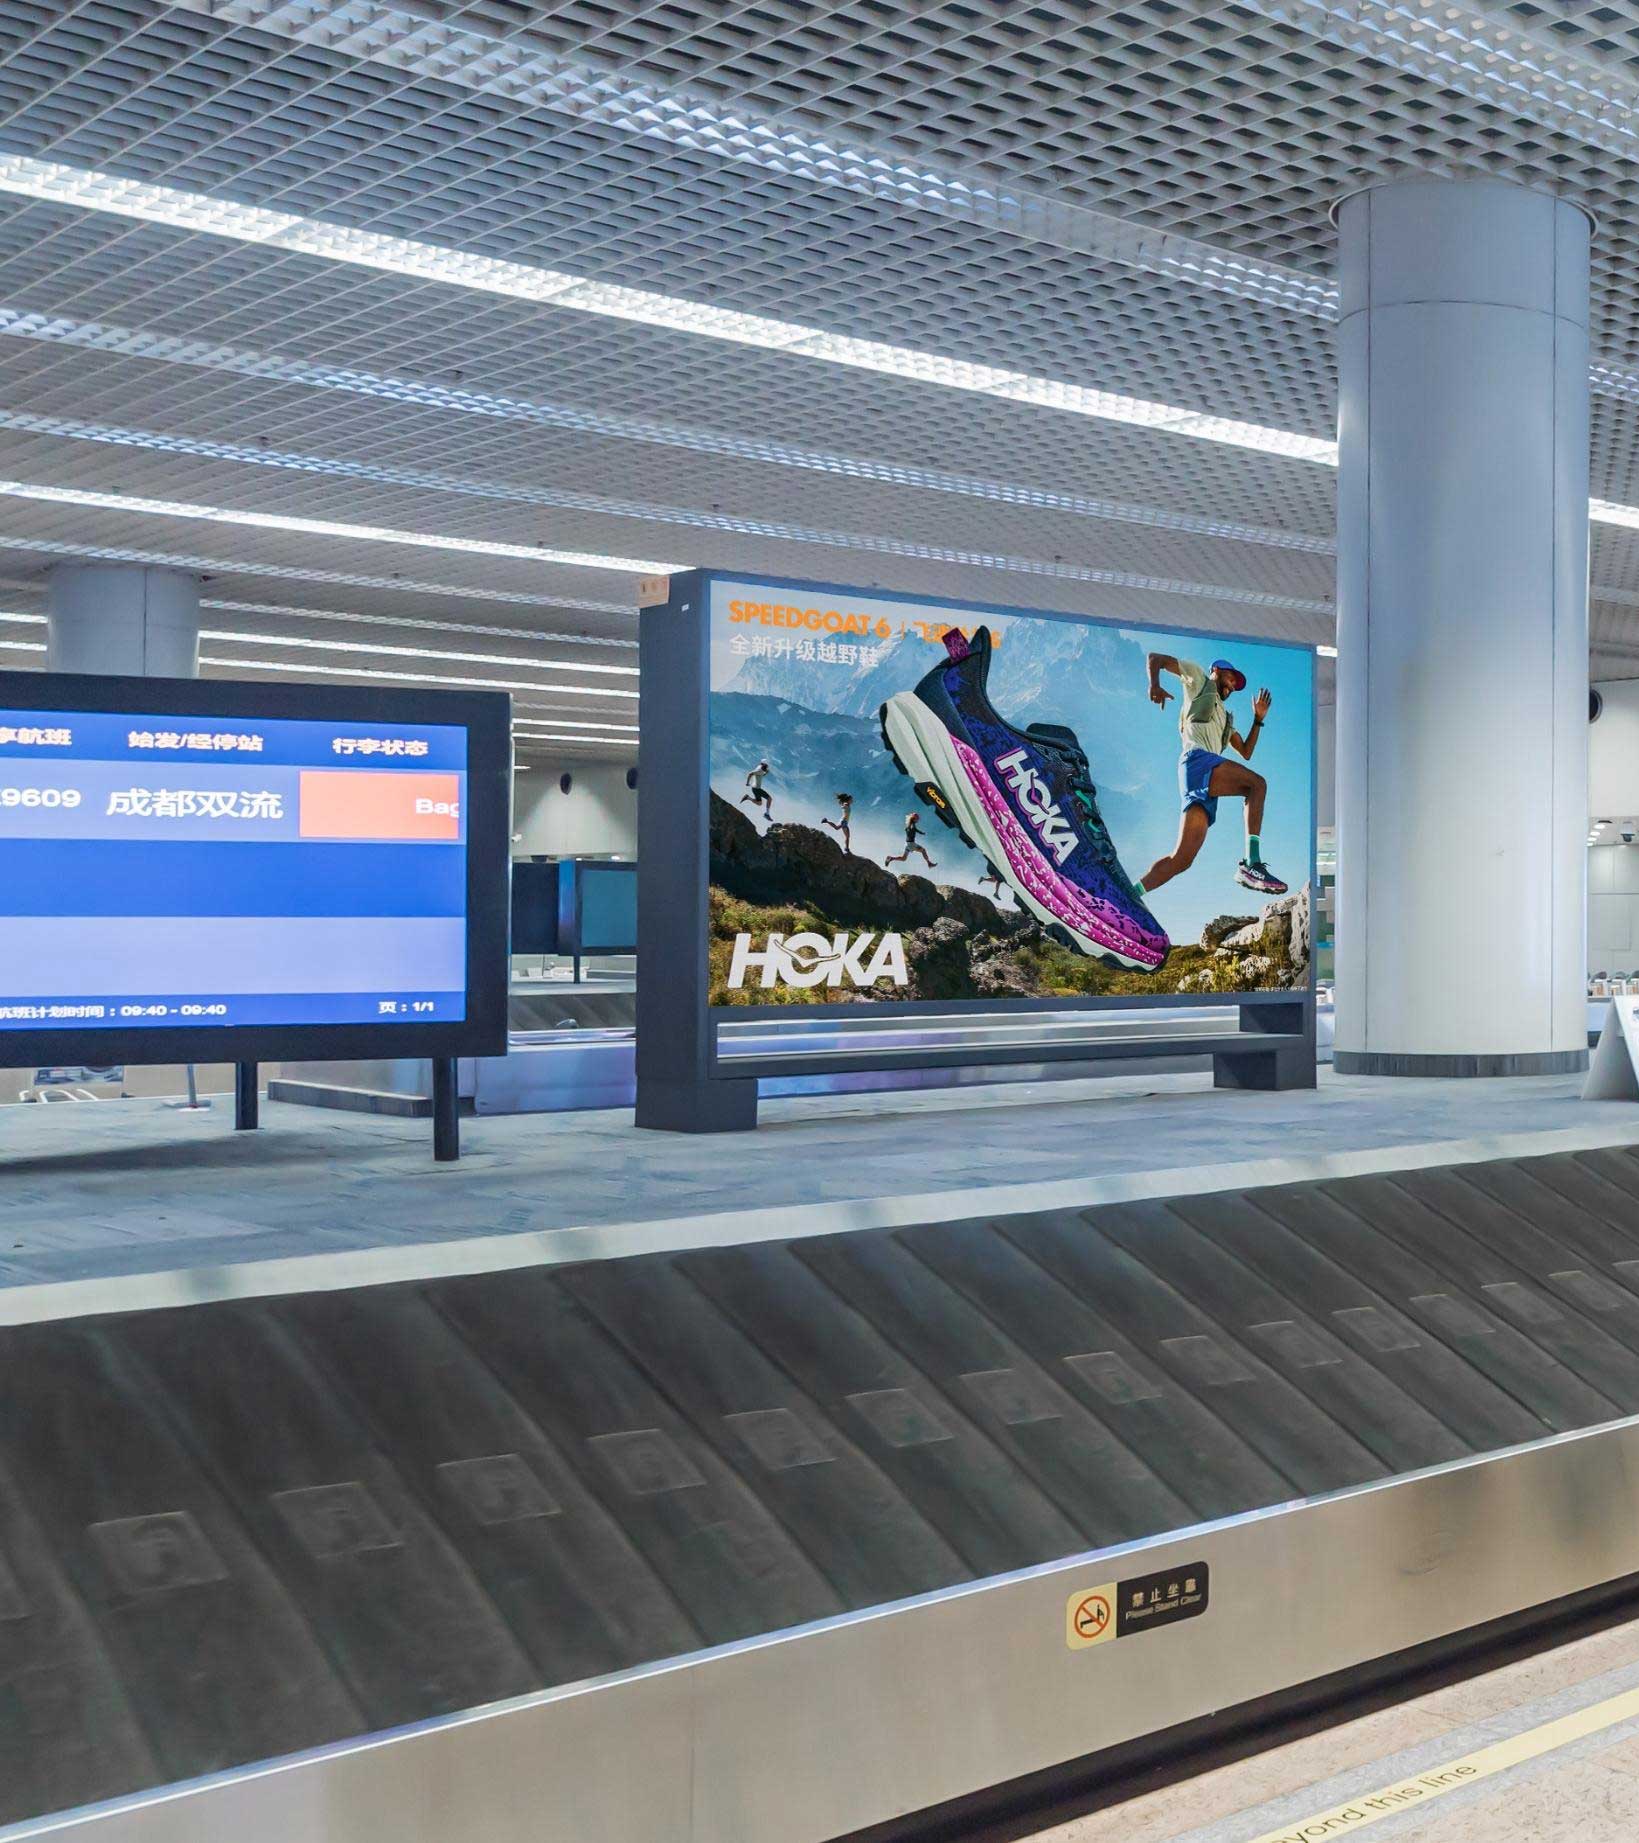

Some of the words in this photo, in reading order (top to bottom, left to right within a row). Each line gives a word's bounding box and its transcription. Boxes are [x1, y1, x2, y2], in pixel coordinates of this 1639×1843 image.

[729, 600, 871, 636] SPEEDGOAT
[874, 618, 891, 638] 6
[729, 634, 879, 667] 全新升级越野鞋
[128, 731, 264, 751] 始发/经停站
[332, 738, 429, 756] 行李状态
[0, 788, 81, 808] 9609
[106, 788, 284, 819] 成都双流
[996, 750, 1080, 864] HOKA
[728, 932, 909, 988] HOKA
[181, 1004, 227, 1015] 09:40
[1126, 1606, 1153, 1620] Please
[1155, 1600, 1179, 1612] Stand
[1364, 1786, 1424, 1810] this
[1419, 1764, 1478, 1789] line
